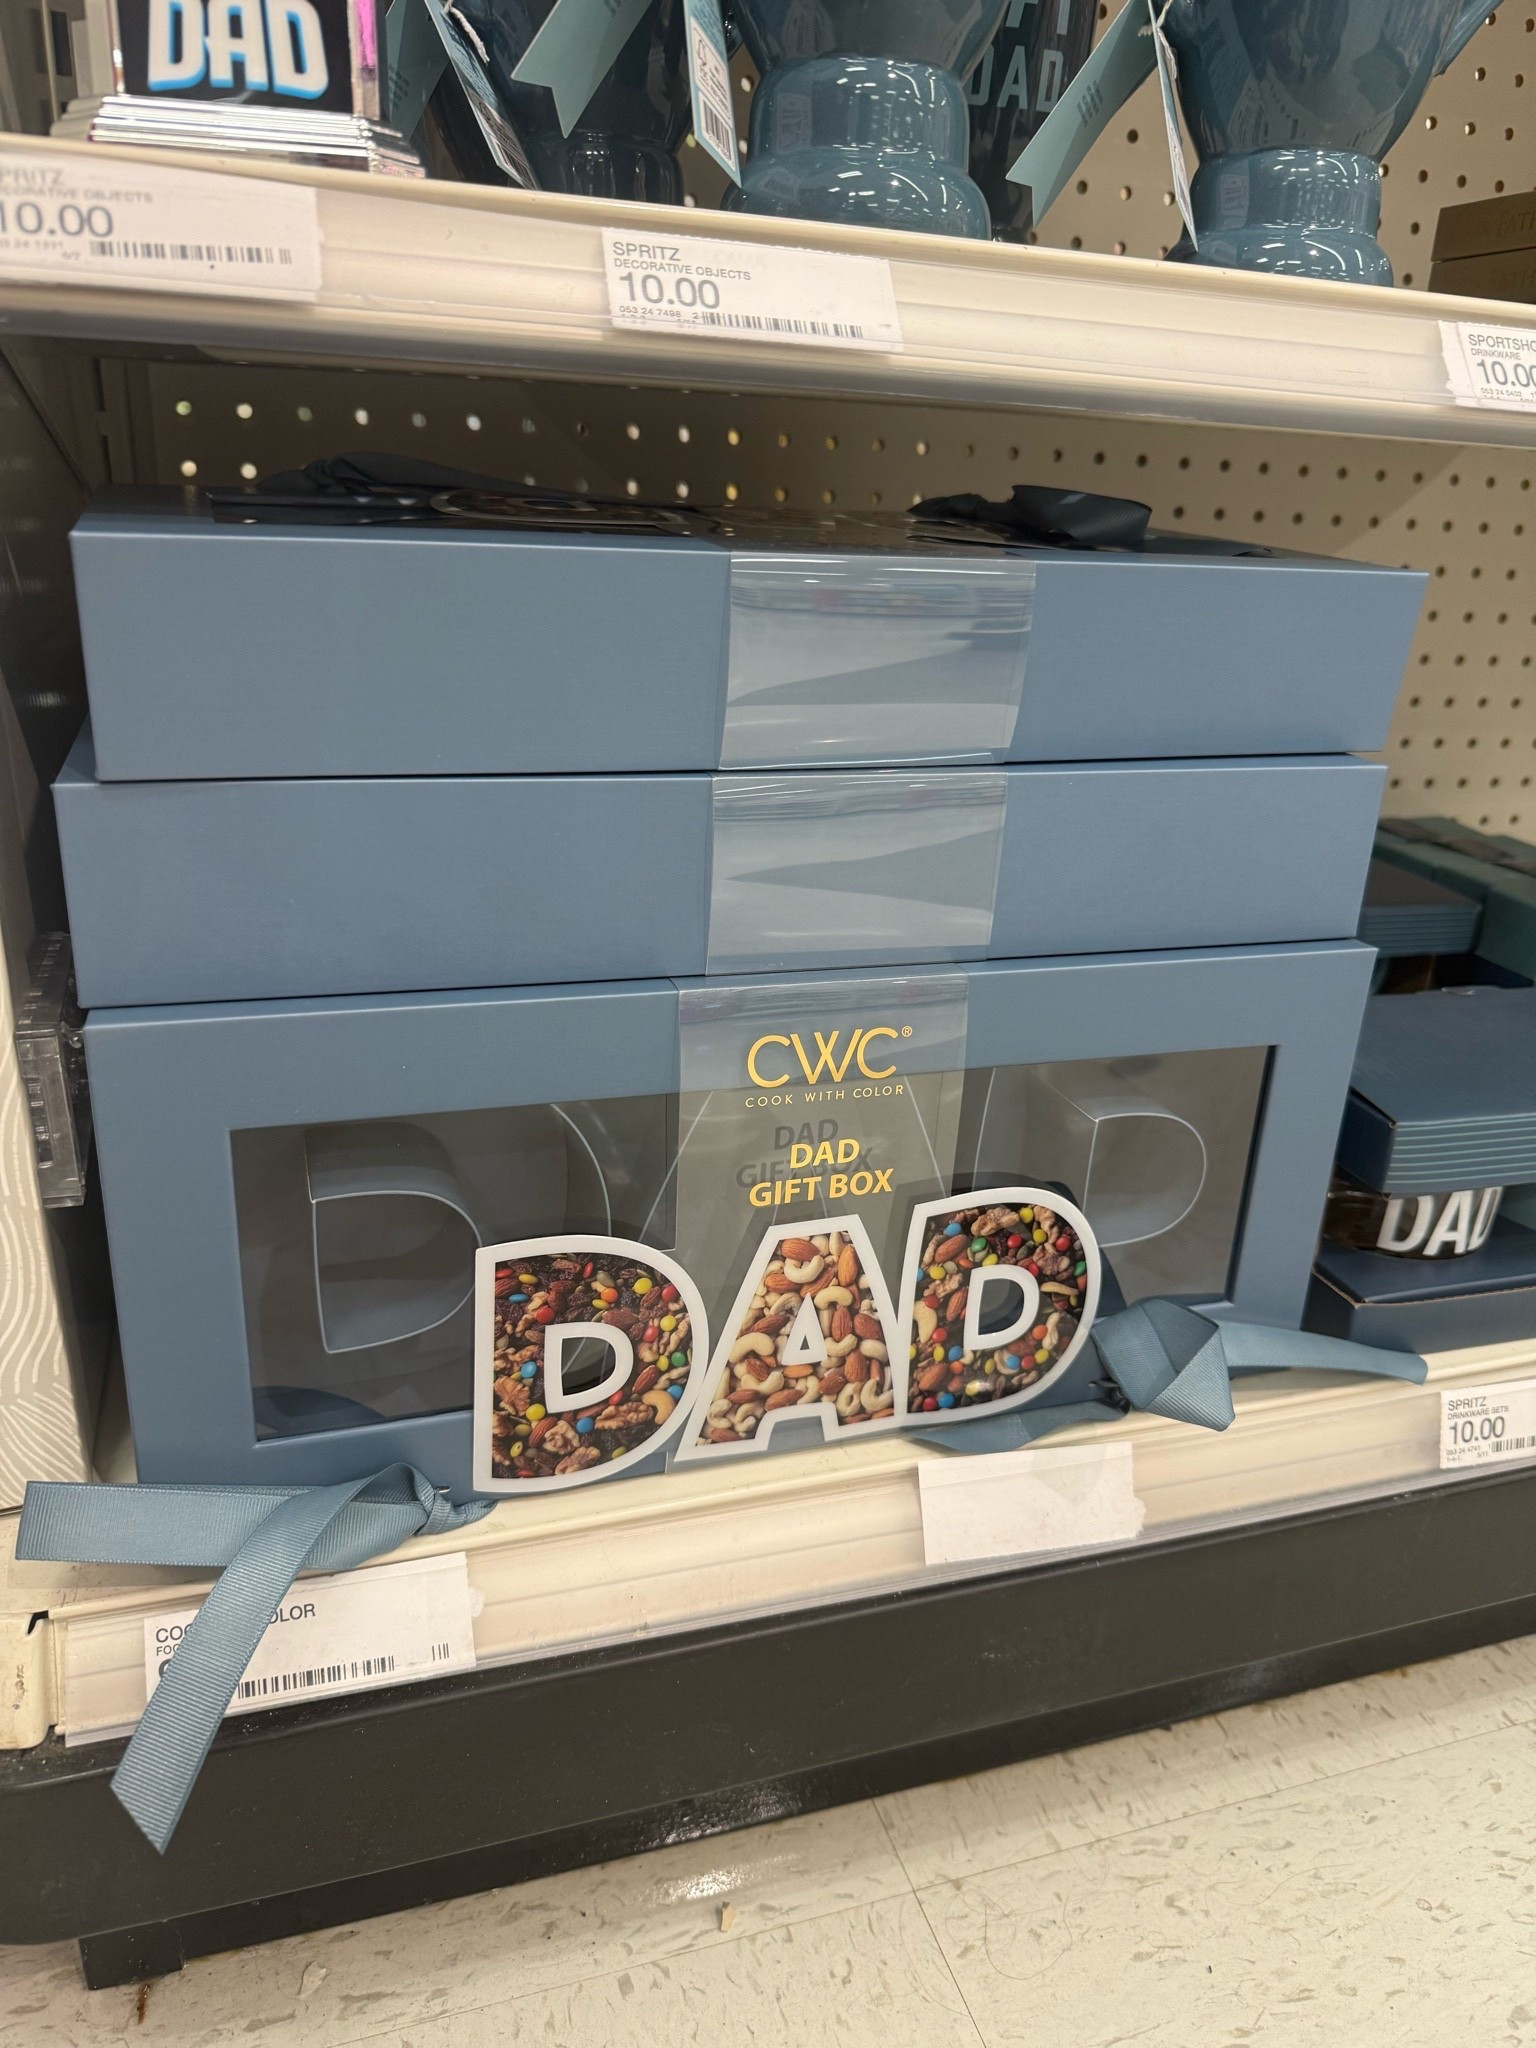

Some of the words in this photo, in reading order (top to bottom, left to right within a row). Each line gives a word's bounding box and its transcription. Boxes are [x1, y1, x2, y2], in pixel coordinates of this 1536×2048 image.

[148, 0, 329, 100] DAD
[963, 42, 1064, 113] DAD
[0, 202, 114, 238] 10.00
[612, 241, 682, 262] SPRITZ
[613, 258, 694, 275] DECORATIVE
[696, 265, 752, 281] OBJECTS
[619, 271, 720, 310] 10.00
[619, 305, 638, 314] 053
[641, 307, 654, 315] 24
[1471, 347, 1522, 361] DRINKWARE
[745, 1093, 793, 1108] COOK
[804, 1090, 845, 1103] WITH
[853, 1084, 904, 1099] COLOR
[789, 1138, 861, 1169] DAD
[749, 1176, 822, 1208] GIFT
[828, 1168, 894, 1200] BOX
[473, 1186, 1101, 1493] DAD
[1447, 1407, 1490, 1420] DRINKWARE
[1491, 1405, 1509, 1414] SETS
[1448, 1396, 1487, 1412] SPRITZ
[1449, 1415, 1505, 1445] 10.00
